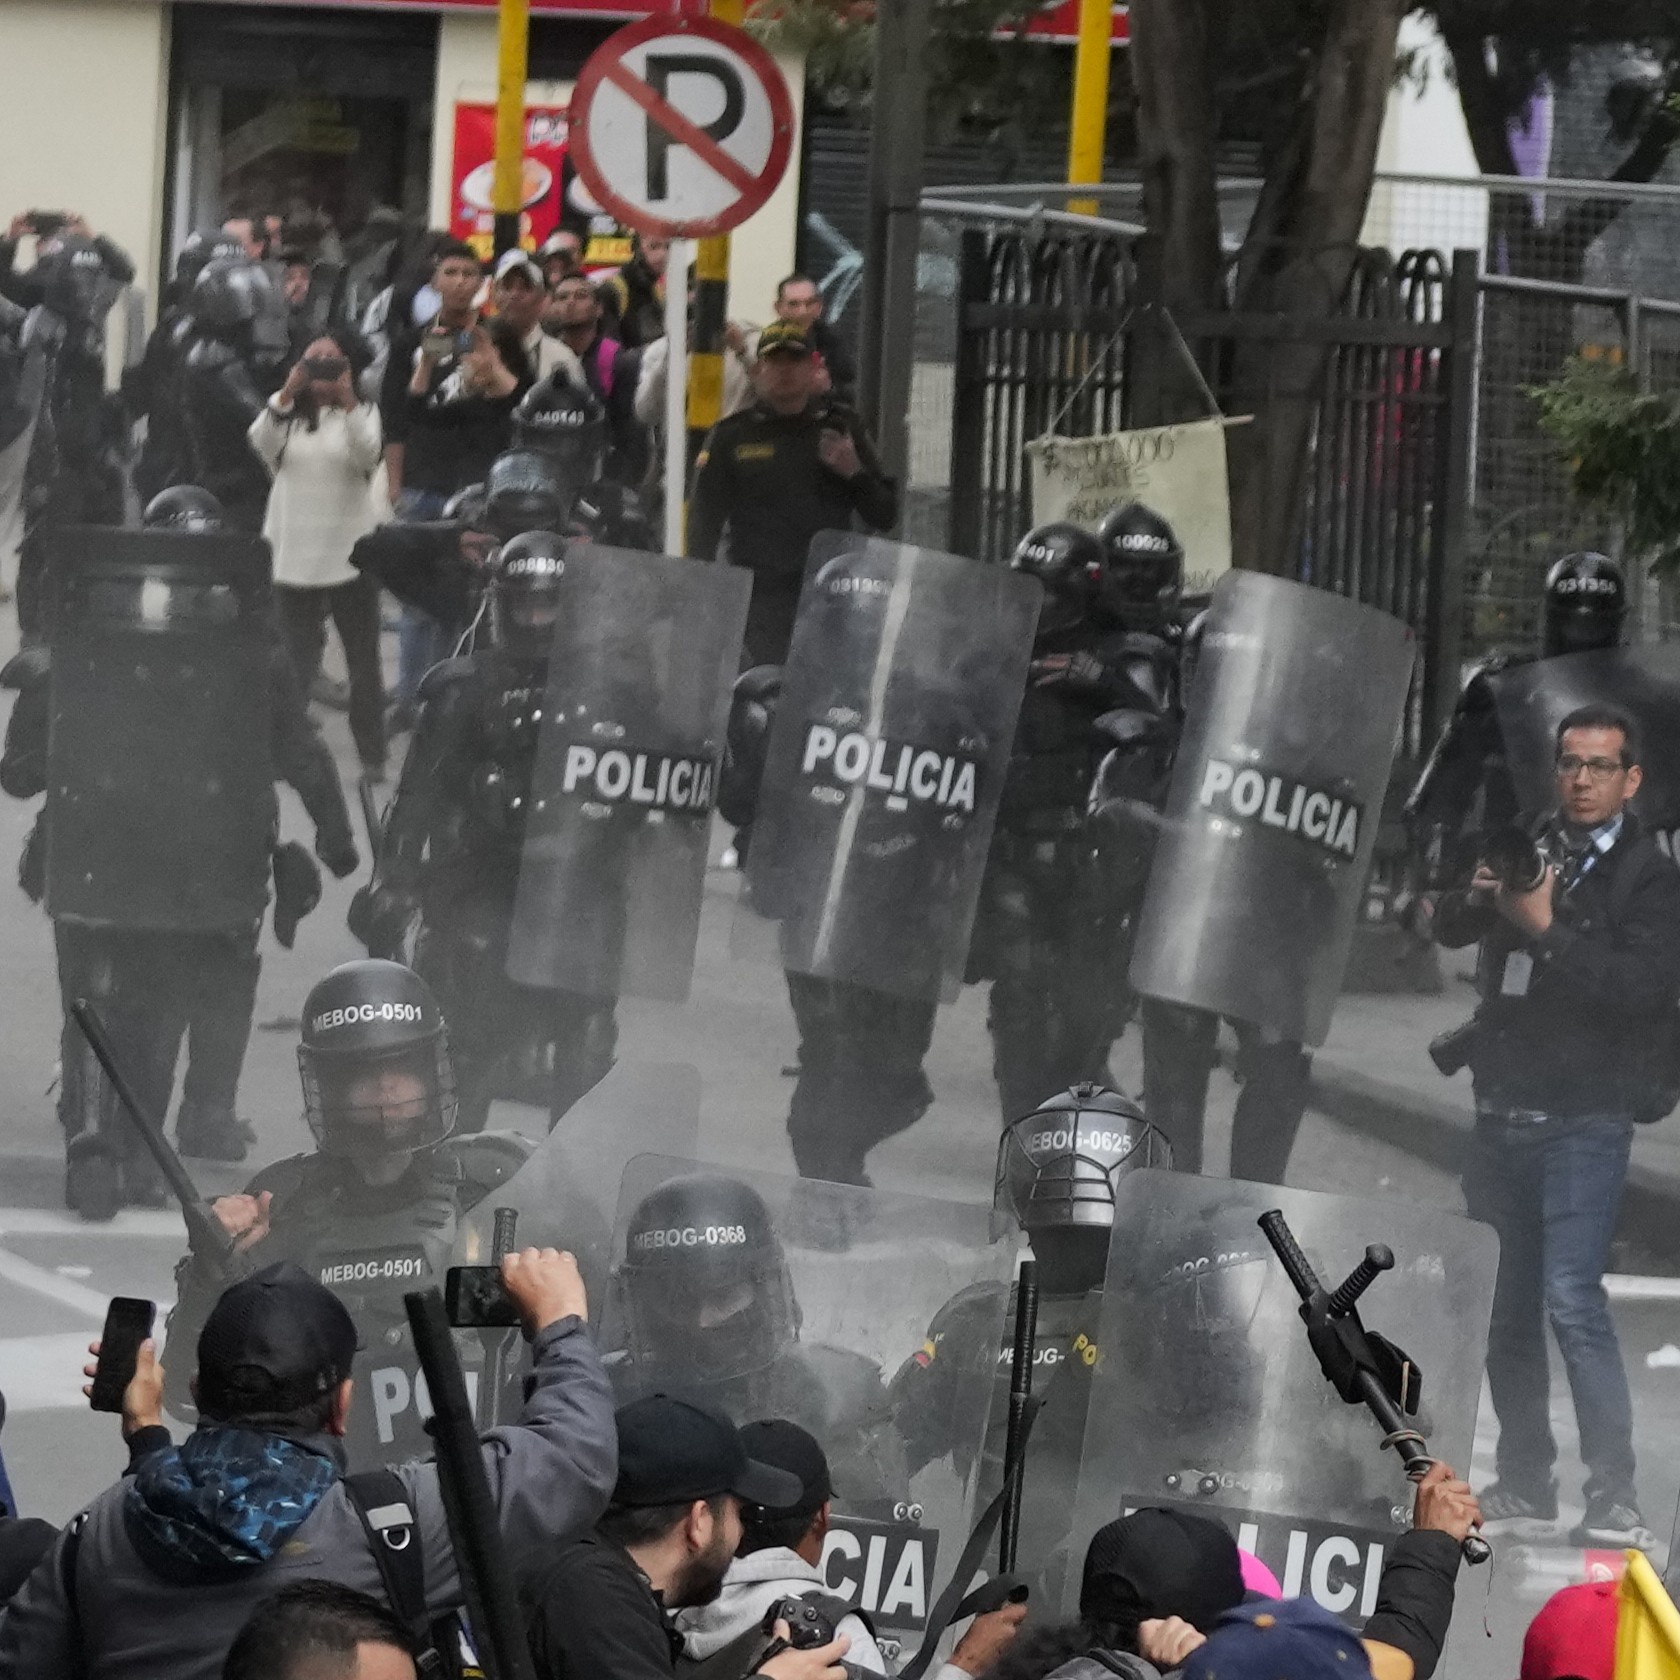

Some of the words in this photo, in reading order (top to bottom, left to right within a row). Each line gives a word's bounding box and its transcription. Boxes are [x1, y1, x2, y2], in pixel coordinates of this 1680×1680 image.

[562, 745, 714, 807] POLICIA
[803, 725, 976, 811] POLICIA
[1199, 760, 1358, 855] POLICIA
[312, 1003, 422, 1032] MEBOG-0501
[1031, 1130, 1133, 1153] EBOG-0625
[634, 1225, 746, 1250] MEBOG-0368
[320, 1258, 423, 1285] MEBOG-0501
